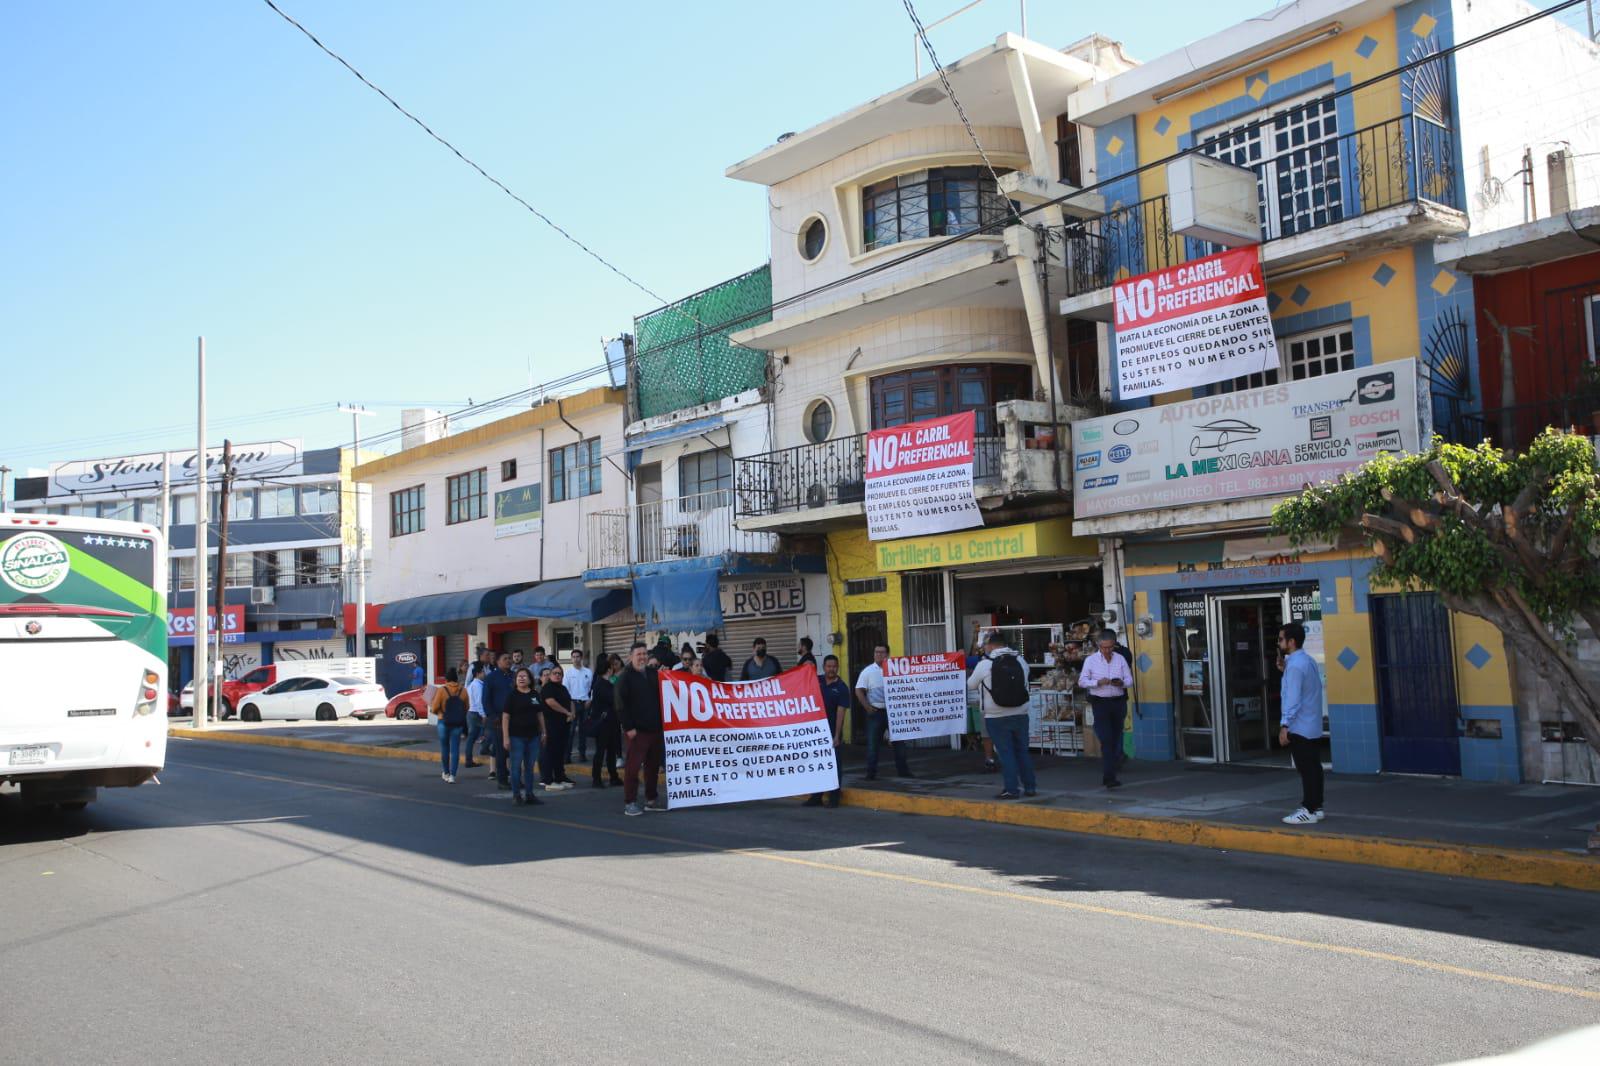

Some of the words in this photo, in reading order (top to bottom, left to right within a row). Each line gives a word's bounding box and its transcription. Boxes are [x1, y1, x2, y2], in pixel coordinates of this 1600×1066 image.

[1158, 274, 1174, 292] AL
[1177, 259, 1226, 285] CARRIL
[1115, 279, 1156, 325] NO
[1158, 273, 1259, 312] PREFERENCIAL
[1119, 334, 1141, 343] MATA
[1142, 330, 1152, 340] LA
[1154, 318, 1200, 336] ECONOMÍA
[1202, 315, 1213, 324] DE
[1215, 312, 1227, 322] LA
[1120, 339, 1163, 355] PROMUEVE
[1166, 336, 1175, 345] EL
[1177, 331, 1207, 343] CIERRE
[1208, 328, 1221, 336] DE
[1223, 315, 1269, 332] FUENTES
[1121, 359, 1133, 368] DE
[1136, 349, 1180, 365] EMPLEOS
[1183, 334, 1248, 354] QUEDANDO
[1252, 328, 1271, 339] SIN
[1122, 362, 1182, 380] SUSTENTO
[1188, 340, 1274, 367] NUMEROSAS
[1123, 379, 1164, 392] FAMILIAS.
[1160, 386, 1290, 424] AUTOPARTES
[1350, 409, 1399, 427] BOSCH
[900, 432, 912, 447] AL
[916, 425, 950, 444] CARRIL
[1294, 439, 1340, 453] SERVICIO
[1344, 438, 1351, 446] A
[1358, 438, 1397, 450] CHAMPION
[868, 435, 898, 473] NO
[898, 440, 970, 466] PREFERENCIAL
[1295, 448, 1347, 462] DOMICILIO
[183, 450, 268, 477] Gm
[1165, 463, 1188, 480] LA
[1192, 448, 1292, 476] MEXICANA
[883, 479, 891, 487] LA
[892, 473, 926, 486] ECONOMÍA
[927, 473, 936, 481] DE
[937, 471, 945, 479] LA
[1145, 493, 1151, 503] Y
[1153, 484, 1212, 502] MENUDEO
[1220, 481, 1240, 493] TEL
[1248, 474, 1303, 489] 982.31.90
[1306, 472, 1315, 481] Y
[867, 490, 900, 500] PROMUEVE
[908, 486, 929, 495] CIERRE
[930, 484, 939, 492] DE
[940, 480, 970, 491] FUENTES
[879, 500, 911, 511] EMPLEOS
[913, 494, 956, 506] QUEDANDO
[959, 492, 972, 500] SIN
[869, 511, 913, 522] SUSTENTO
[917, 502, 976, 517] NUMEROSAS
[947, 544, 963, 561] La
[968, 532, 1024, 558] Central
[15, 569, 60, 585] CALIDAD
[735, 589, 802, 613] ROBLE
[1292, 595, 1320, 604] HORARI
[1292, 603, 1321, 611] CORRID
[1174, 608, 1205, 616] CORRIDO
[888, 658, 910, 676] NO
[911, 656, 919, 664] AL
[922, 654, 946, 662] CARRIL
[911, 663, 960, 673] PREFERENCIAL
[712, 683, 729, 699] AL
[733, 679, 785, 698] CARRIL
[662, 680, 714, 723] NO
[714, 695, 820, 720] PREFERENCIAL
[890, 708, 944, 717] QUEDANDO
[891, 717, 925, 725] SUSTENTO
[666, 735, 691, 744] MATA
[694, 734, 707, 742] LA
[710, 732, 763, 742] ECONOMÍA
[779, 729, 790, 738] LA
[666, 745, 720, 758] PROMUEVE
[736, 744, 769, 753] CIERRE
[772, 743, 784, 751] DE
[787, 737, 829, 750] FUENTES
[667, 764, 679, 772] DE
[685, 759, 738, 771] EMPLEOS
[742, 752, 809, 766] QUEDANDO
[813, 749, 832, 758] SIN
[668, 772, 739, 786] SUSTENTO
[746, 762, 833, 779] NUMEROSAS
[668, 788, 716, 800] FAMILIAS.
